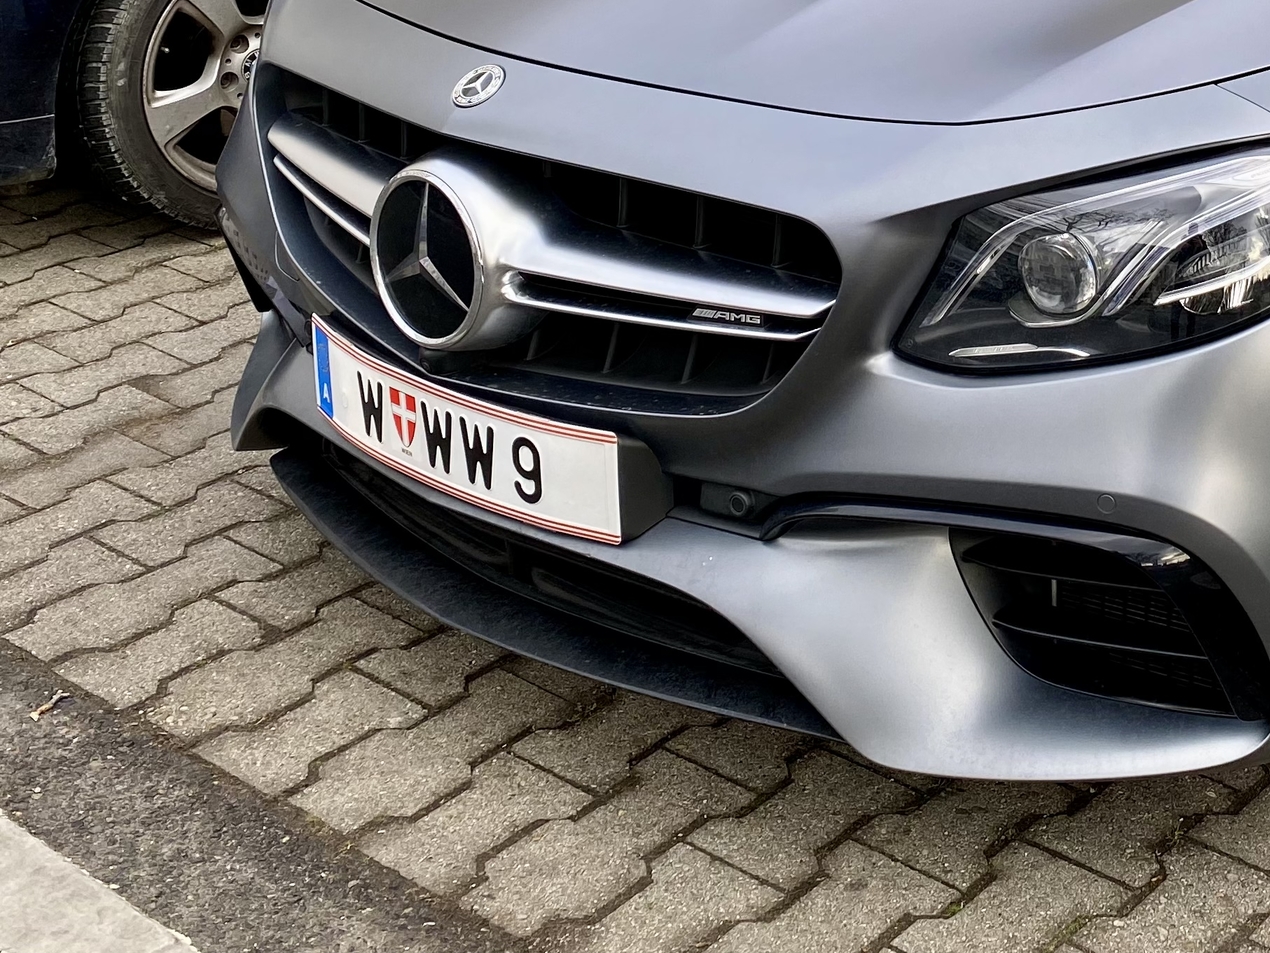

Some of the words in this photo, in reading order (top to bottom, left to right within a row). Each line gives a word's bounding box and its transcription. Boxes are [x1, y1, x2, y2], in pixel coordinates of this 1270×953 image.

[713, 310, 761, 324] AMG
[323, 382, 331, 403] A
[512, 436, 543, 504] 9
